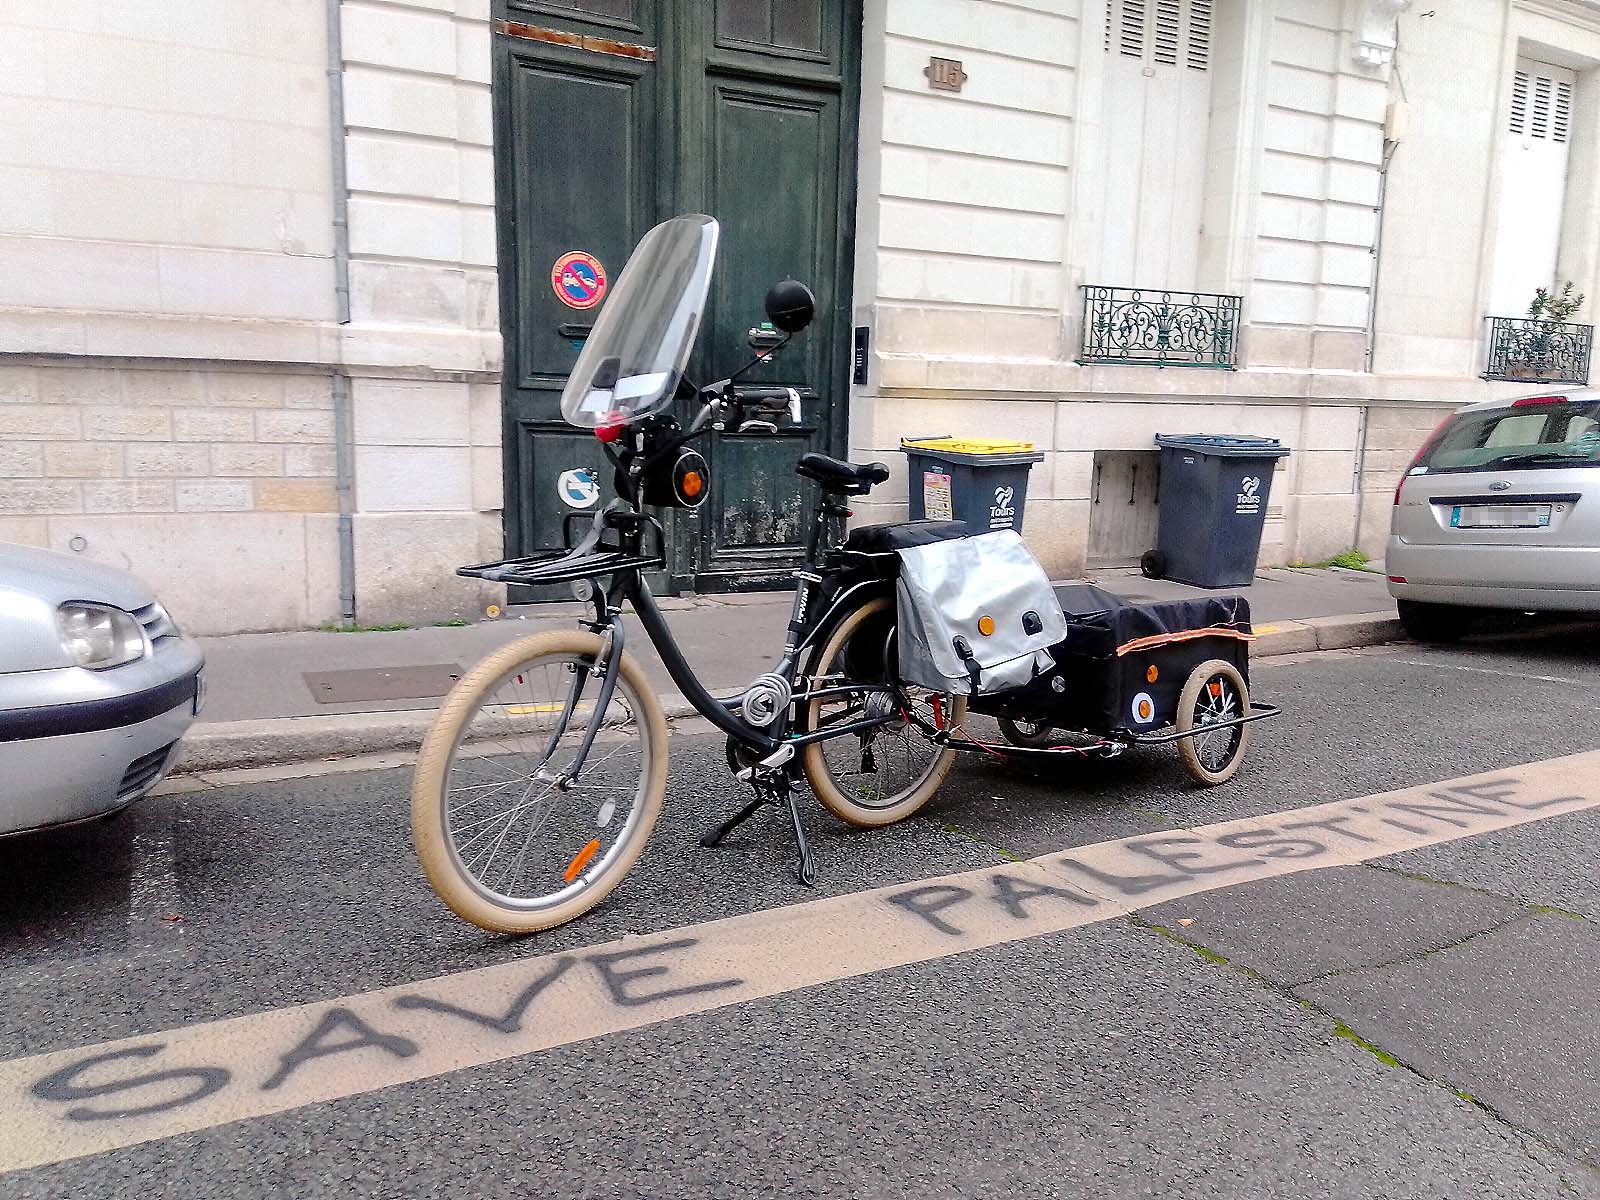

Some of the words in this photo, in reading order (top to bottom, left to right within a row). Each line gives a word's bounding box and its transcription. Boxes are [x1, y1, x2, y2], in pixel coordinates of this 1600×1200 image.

[933, 60, 960, 88] 115
[31, 937, 745, 1120] SAVE
[889, 778, 1586, 936] PALESTINE
